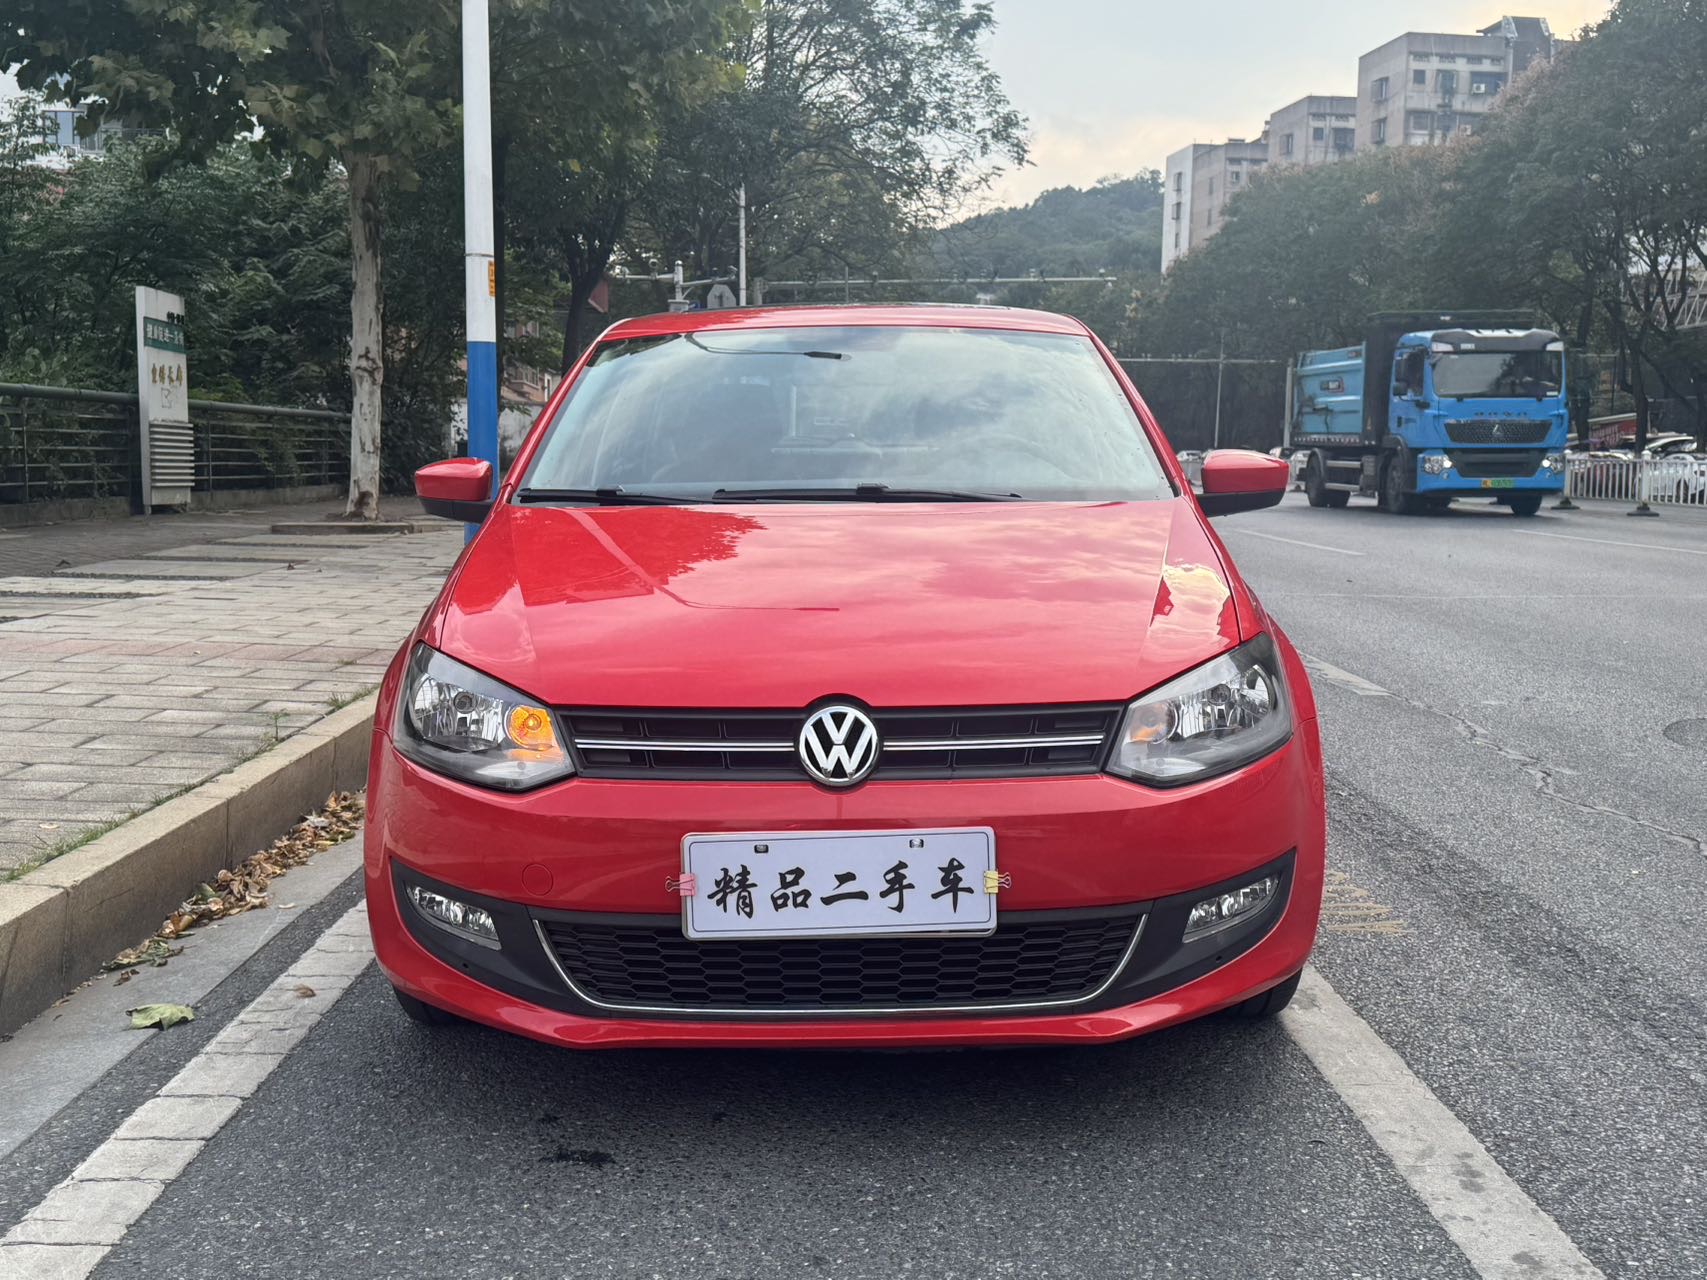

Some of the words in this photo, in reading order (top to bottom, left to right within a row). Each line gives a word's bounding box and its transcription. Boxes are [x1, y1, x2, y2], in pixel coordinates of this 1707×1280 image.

[801, 706, 877, 781] VW
[707, 857, 974, 919] 精品二手车
